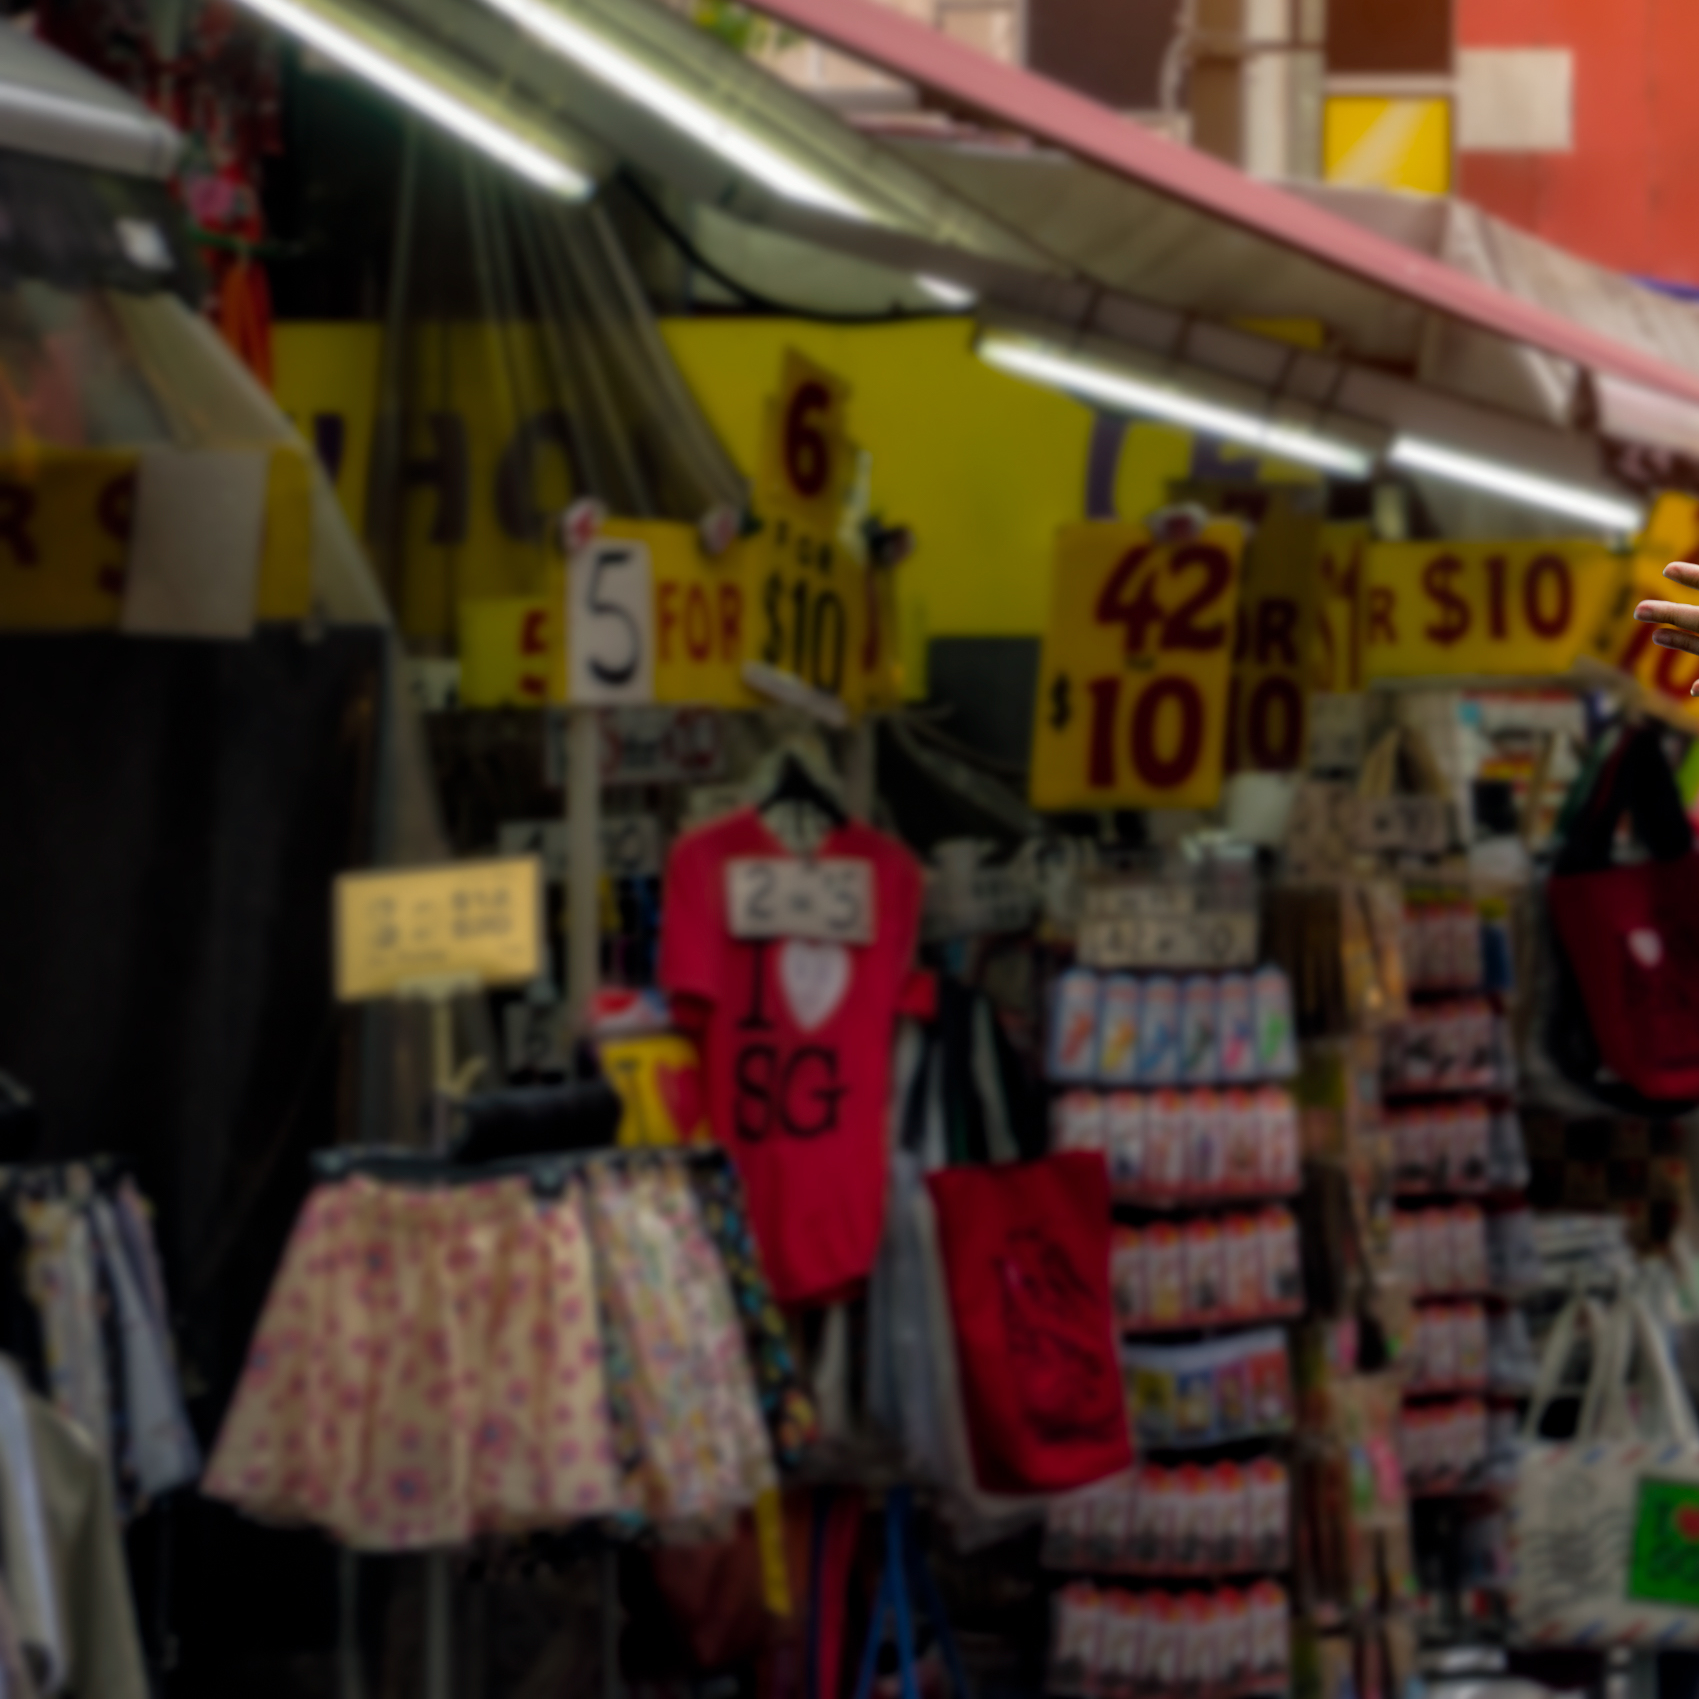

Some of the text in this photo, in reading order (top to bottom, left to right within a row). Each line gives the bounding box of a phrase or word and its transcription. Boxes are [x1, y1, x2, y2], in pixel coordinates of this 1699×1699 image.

[785, 381, 830, 497] 6
[588, 551, 641, 685] 5
[660, 582, 742, 664] FOR
[762, 570, 846, 697] $10
[1095, 546, 1231, 654] 42
[1422, 553, 1572, 646] $10
[745, 863, 776, 921] 2
[735, 1044, 848, 1143] SG
